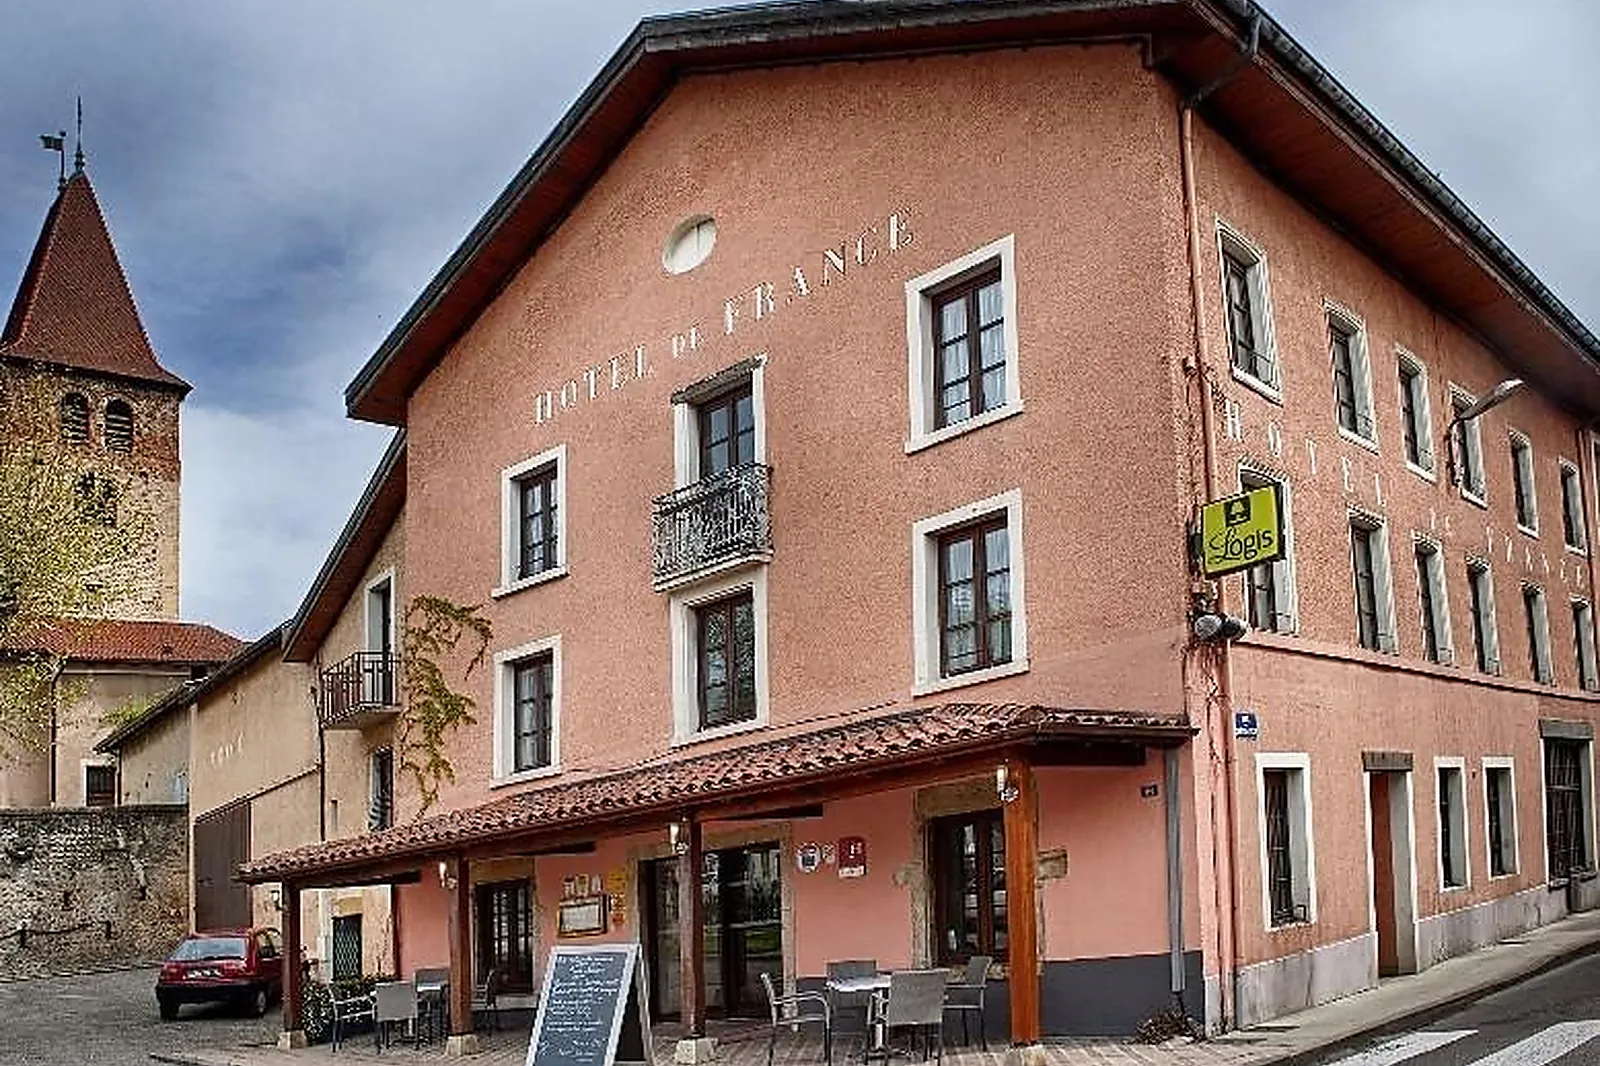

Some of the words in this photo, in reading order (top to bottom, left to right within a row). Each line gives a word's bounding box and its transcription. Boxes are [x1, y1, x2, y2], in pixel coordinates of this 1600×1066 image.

[533, 345, 653, 425] HOTEL
[723, 211, 914, 336] FRANCE
[1208, 528, 1274, 563] Logis
